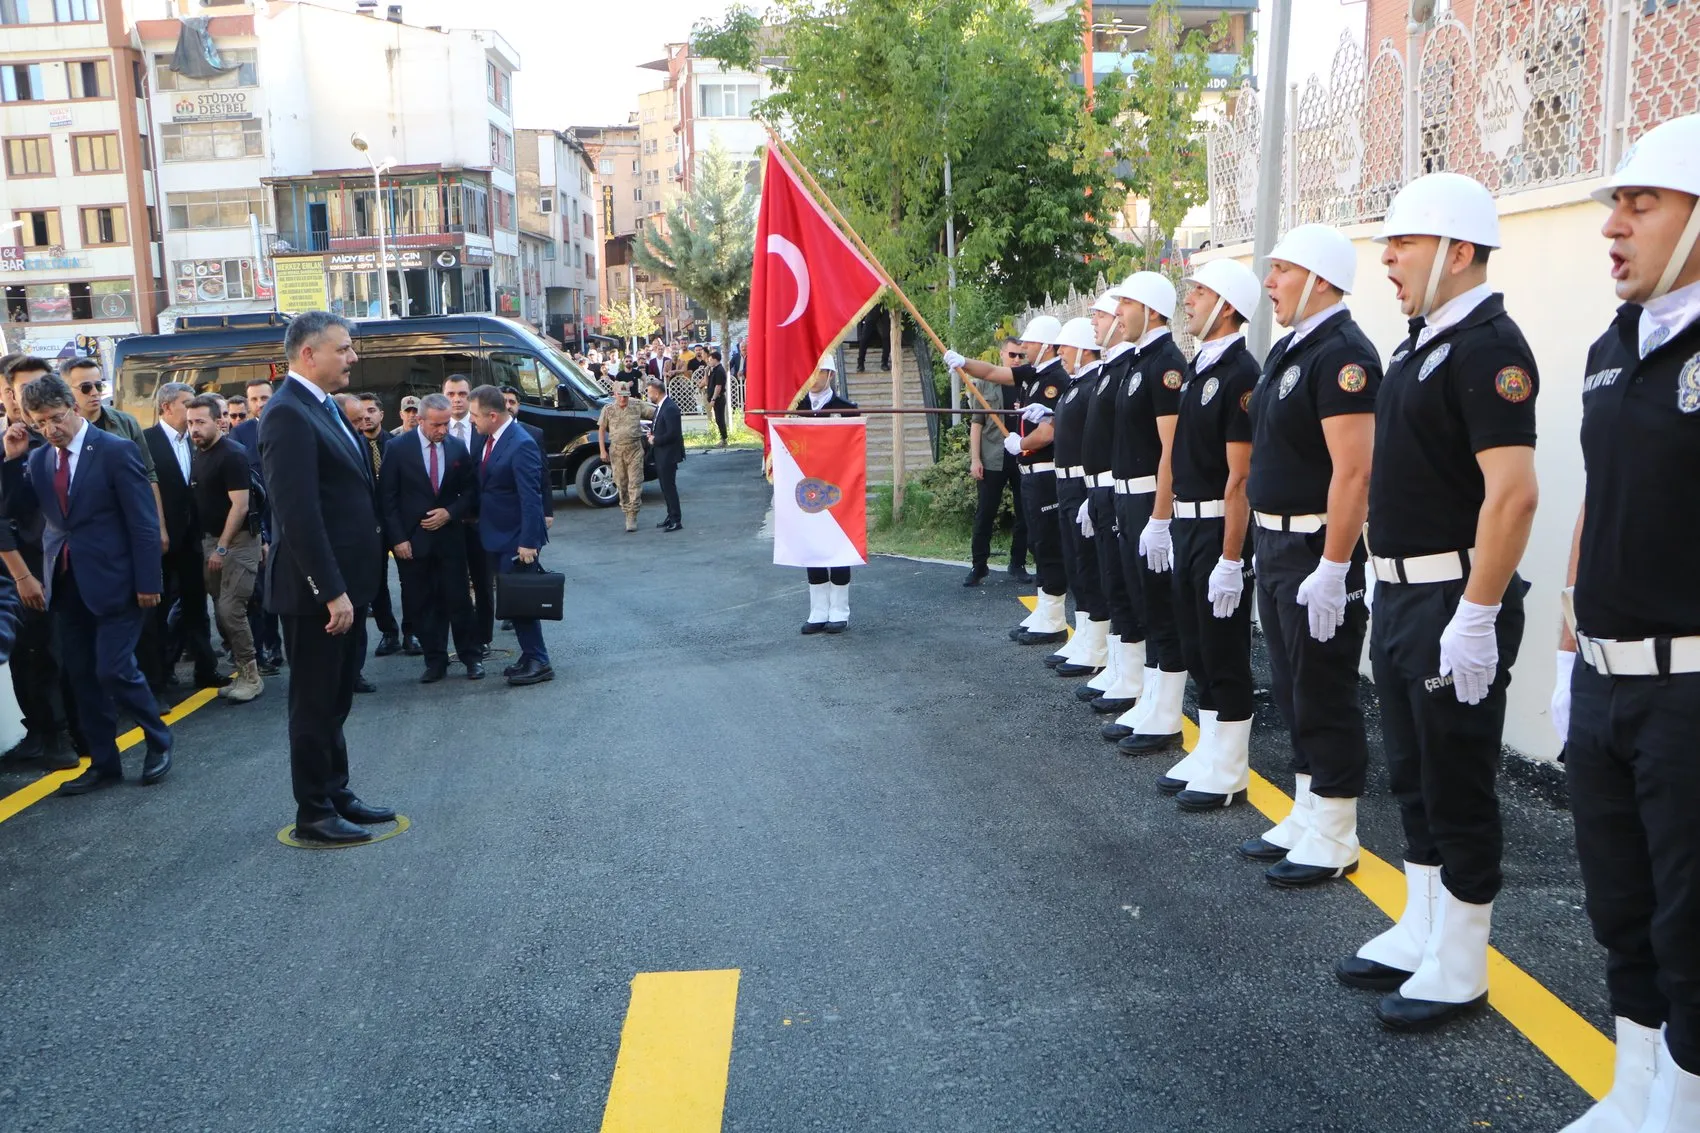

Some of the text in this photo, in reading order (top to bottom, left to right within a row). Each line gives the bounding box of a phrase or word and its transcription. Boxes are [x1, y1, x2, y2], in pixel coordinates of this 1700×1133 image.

[197, 92, 247, 105] STÜDYO
[199, 103, 248, 115] DESİBEL
[331, 252, 420, 263] MİDYECİ YAÇIN
[1, 259, 26, 271] BAR
[32, 344, 61, 352] TÜRKCELL
